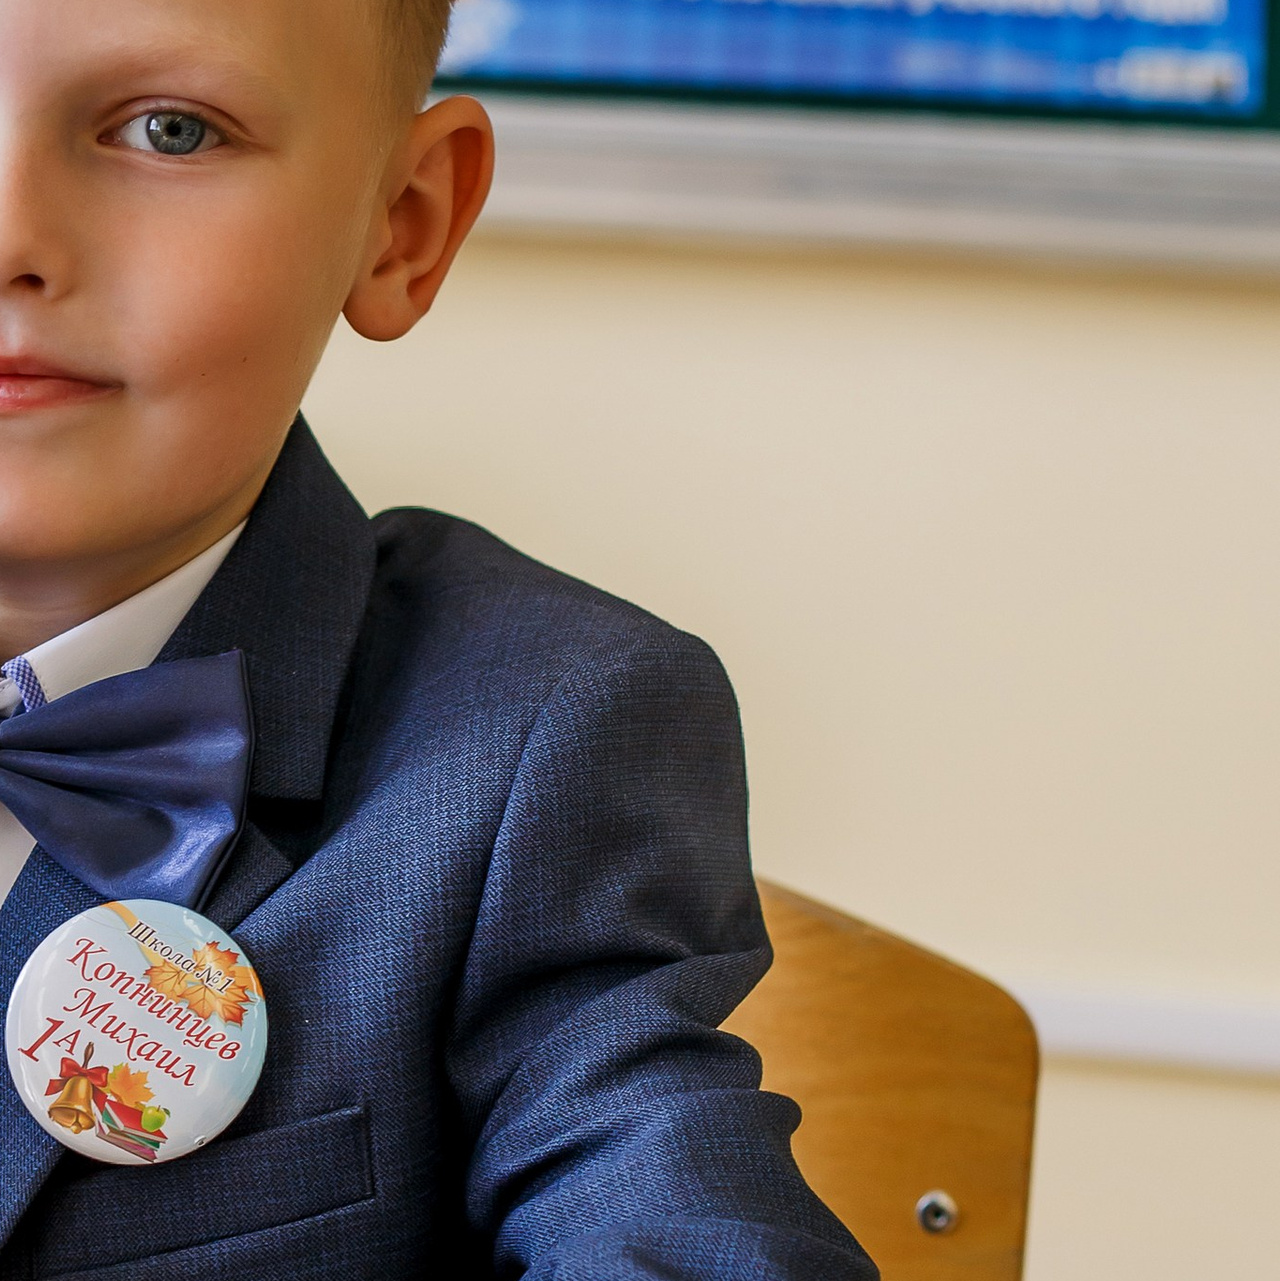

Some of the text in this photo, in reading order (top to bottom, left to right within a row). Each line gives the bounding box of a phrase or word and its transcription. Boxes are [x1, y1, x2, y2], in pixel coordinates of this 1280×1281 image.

[67, 938, 241, 1061] Копнинцев
[127, 921, 235, 994] Школа №1
[63, 988, 198, 1087] Михаил
